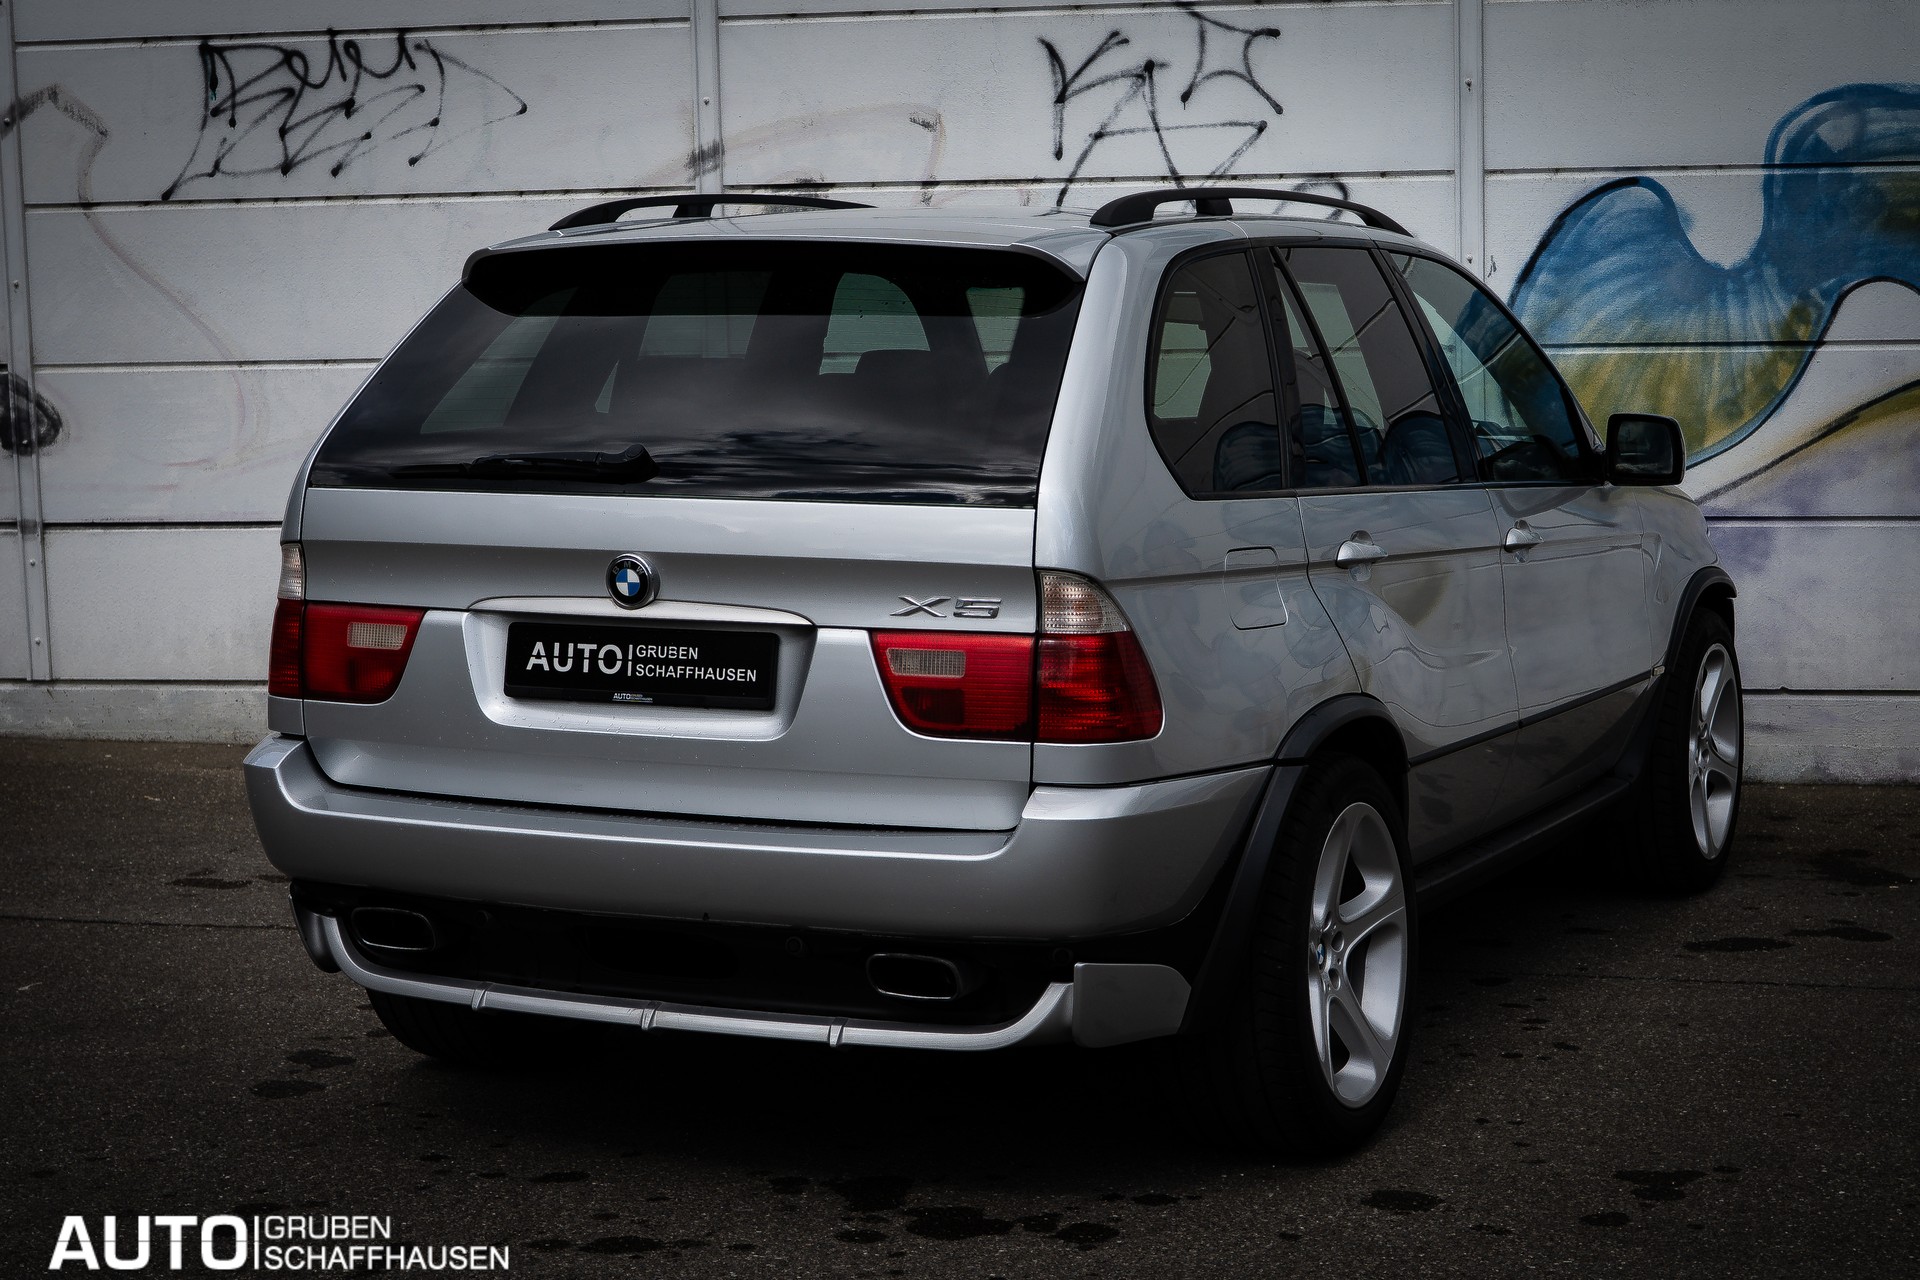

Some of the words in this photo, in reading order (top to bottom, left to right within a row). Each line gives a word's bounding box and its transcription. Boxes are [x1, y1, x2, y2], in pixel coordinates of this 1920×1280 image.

[612, 560, 645, 576] BMW
[889, 595, 1002, 619] X5
[526, 641, 623, 675] AUTO
[636, 644, 699, 660] GRUBEN
[636, 664, 757, 682] SCHAFFHAUSEN
[613, 692, 631, 700] AUTO
